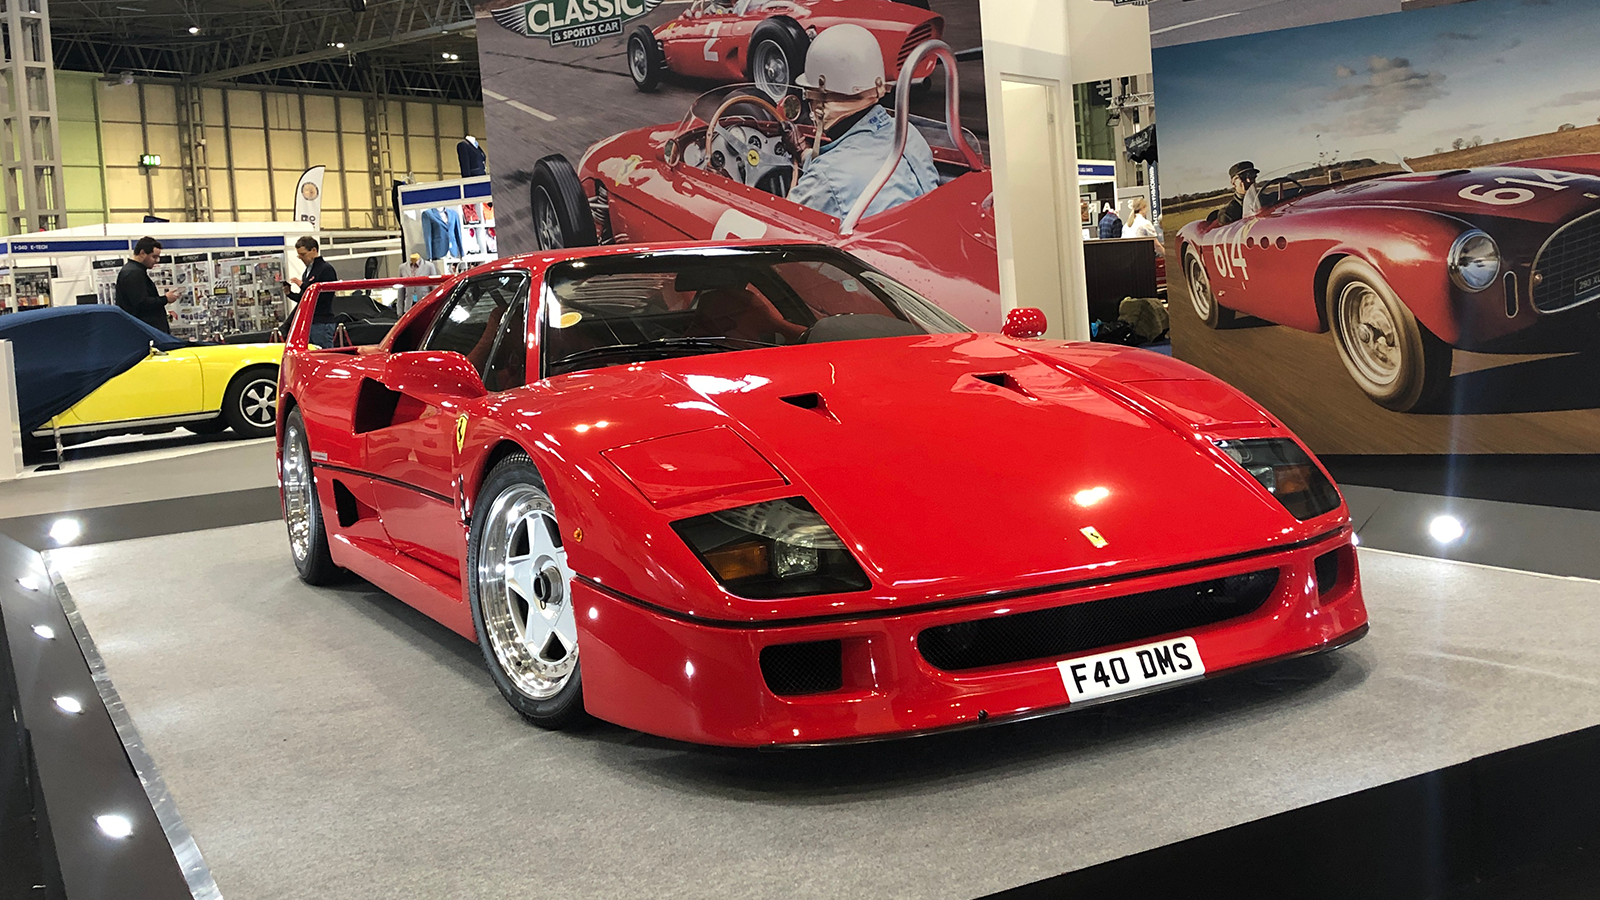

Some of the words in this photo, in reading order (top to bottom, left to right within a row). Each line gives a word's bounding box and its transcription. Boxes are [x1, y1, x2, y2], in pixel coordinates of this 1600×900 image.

[527, 0, 644, 33] CLASSIC
[553, 31, 562, 42] &
[562, 26, 597, 40] SPORTS
[599, 21, 619, 34] CAR
[703, 21, 723, 62] 2
[1458, 171, 1577, 205] 614
[1213, 225, 1249, 280] 614
[1070, 656, 1130, 694] F40
[1135, 642, 1193, 679] DMS
